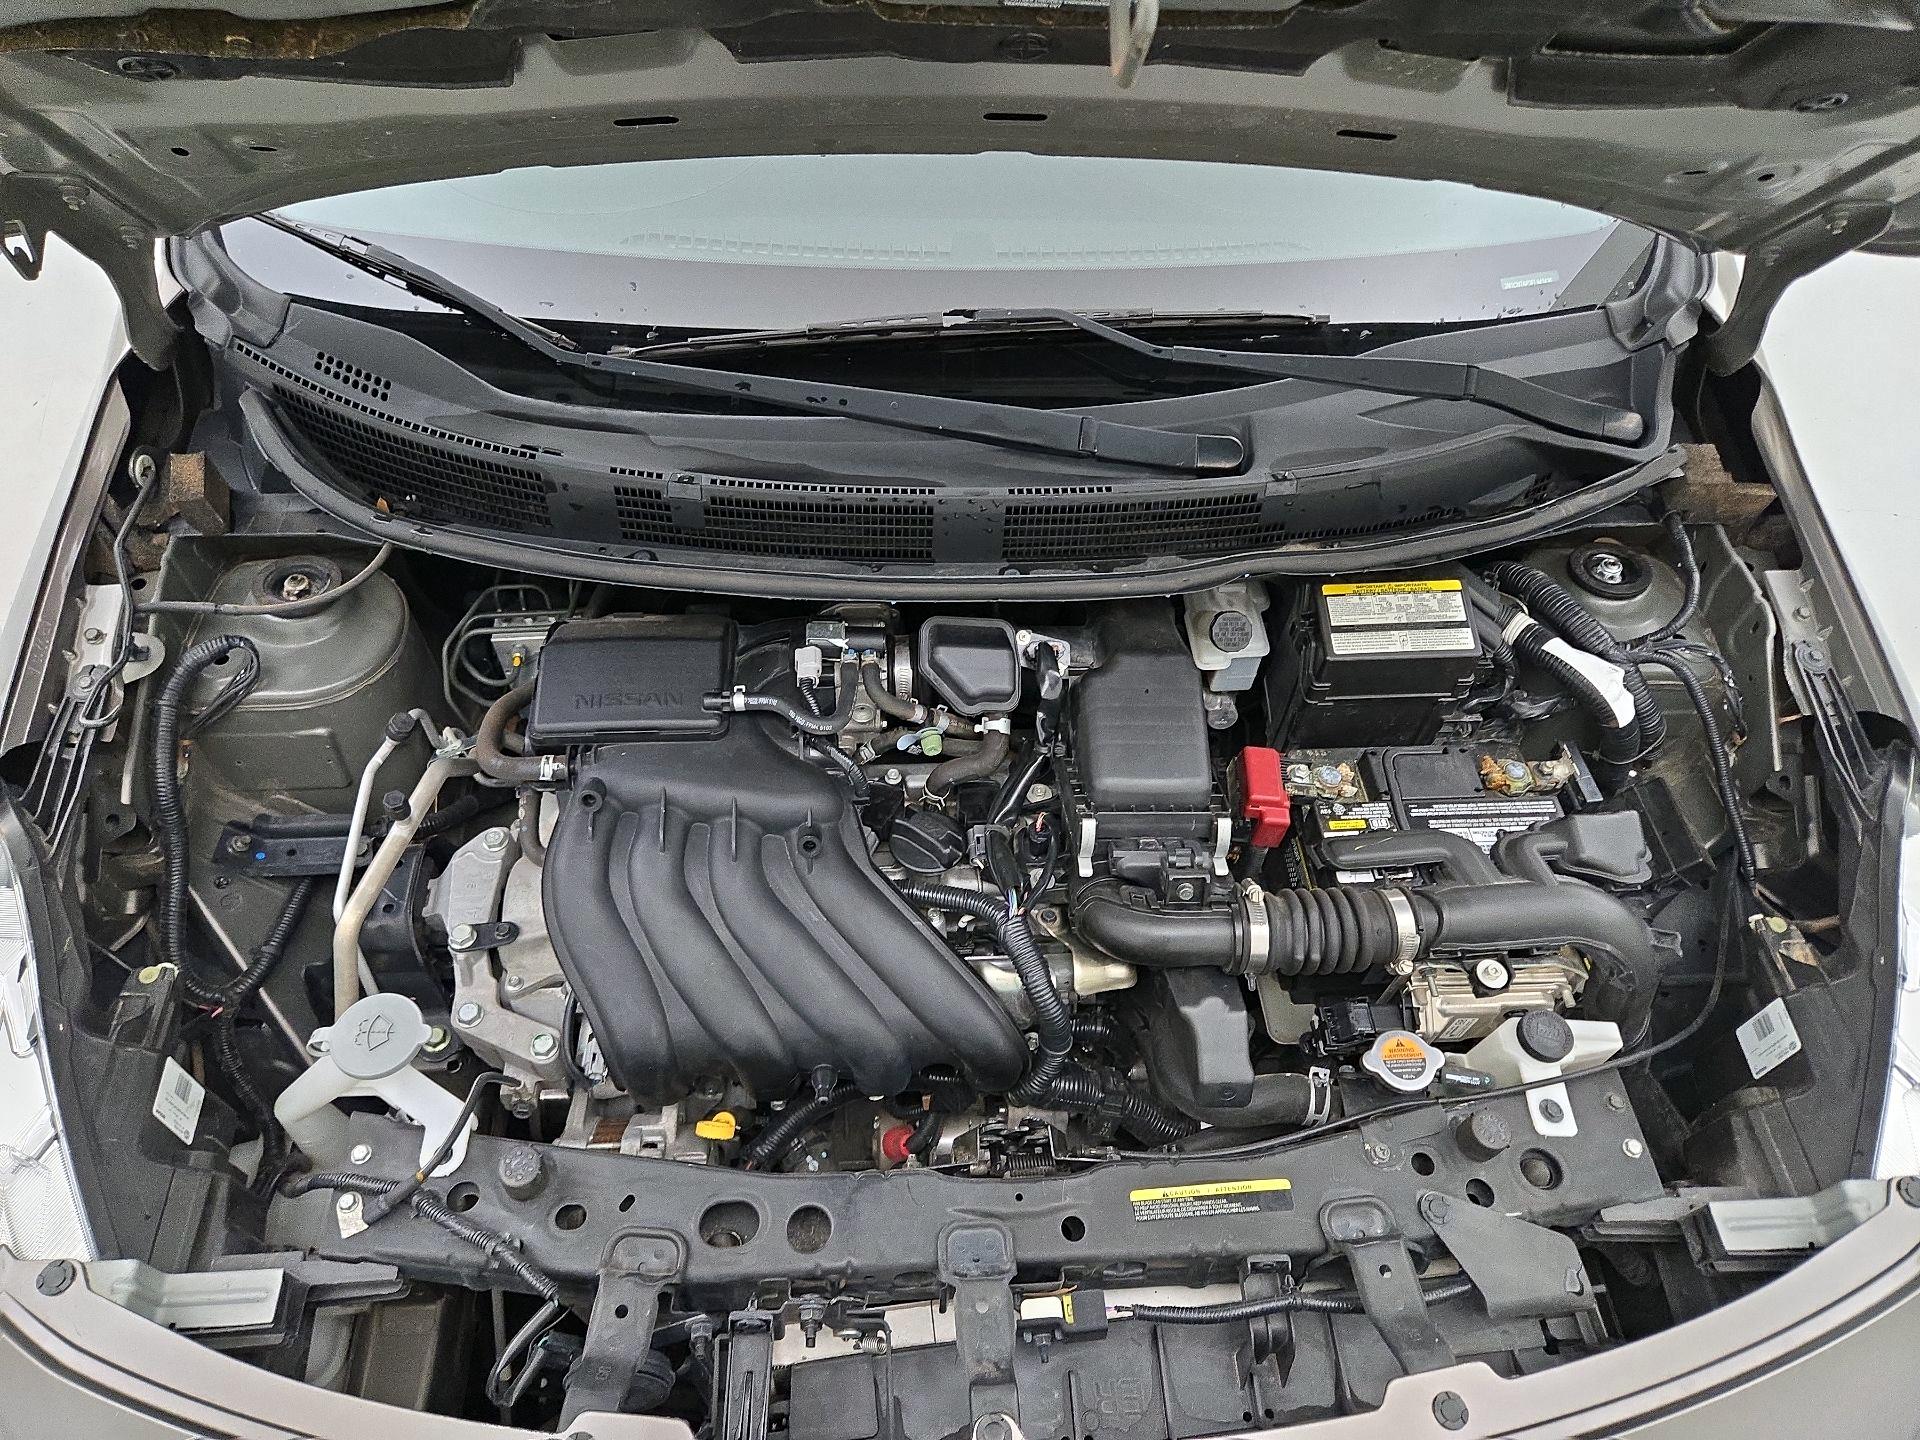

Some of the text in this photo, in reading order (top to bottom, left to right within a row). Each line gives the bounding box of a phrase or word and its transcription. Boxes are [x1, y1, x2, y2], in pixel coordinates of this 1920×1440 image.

[575, 692, 683, 709] NISSAN
[1169, 1189, 1201, 1197] CAUTION
[1215, 1185, 1252, 1193] ATTENTION
